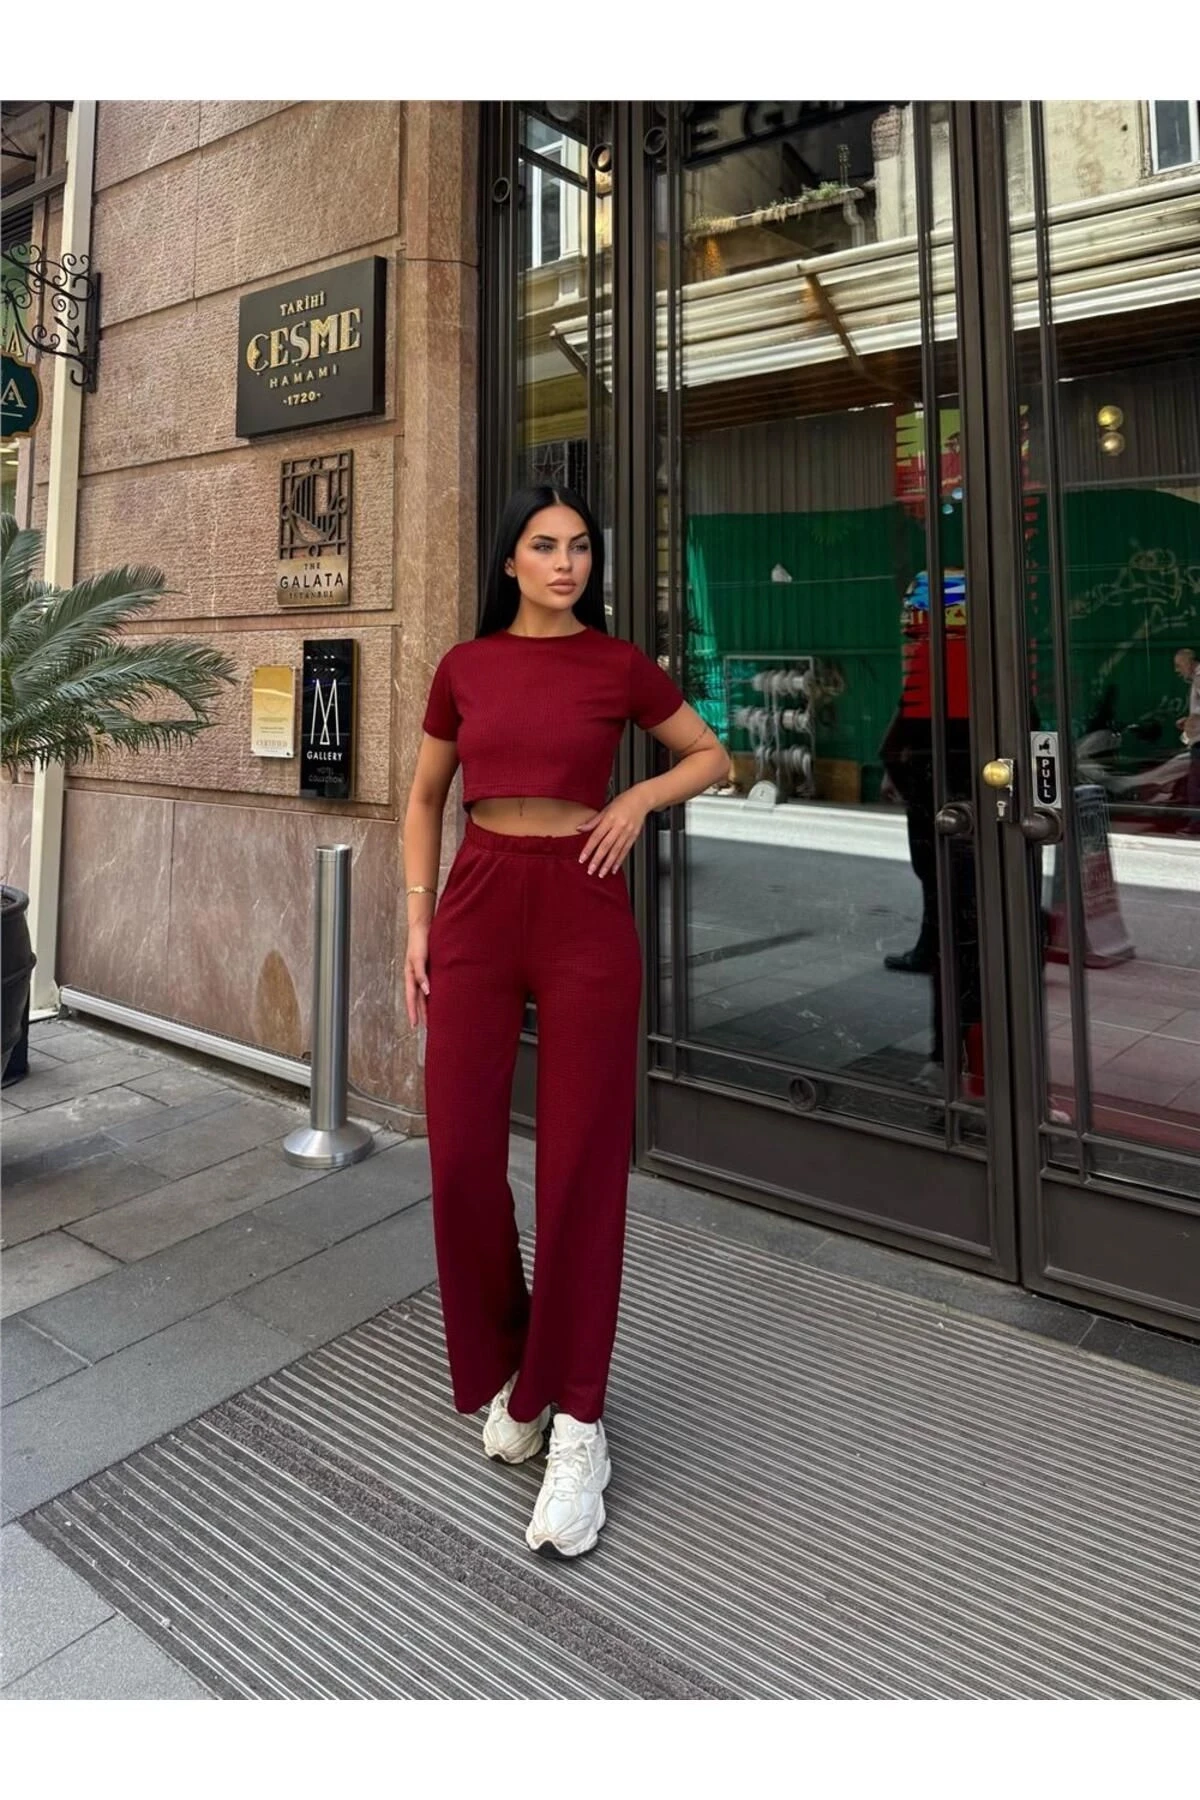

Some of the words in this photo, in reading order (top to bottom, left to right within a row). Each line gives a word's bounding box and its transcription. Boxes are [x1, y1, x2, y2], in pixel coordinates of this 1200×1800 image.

[280, 291, 325, 316] TARİHİ
[247, 308, 360, 375] ÇEŞME
[269, 364, 337, 388] HAMAMI
[304, 562, 320, 570] THE
[280, 572, 344, 589] GALATA
[306, 751, 343, 761] GALLERY
[1041, 758, 1051, 798] PULL
